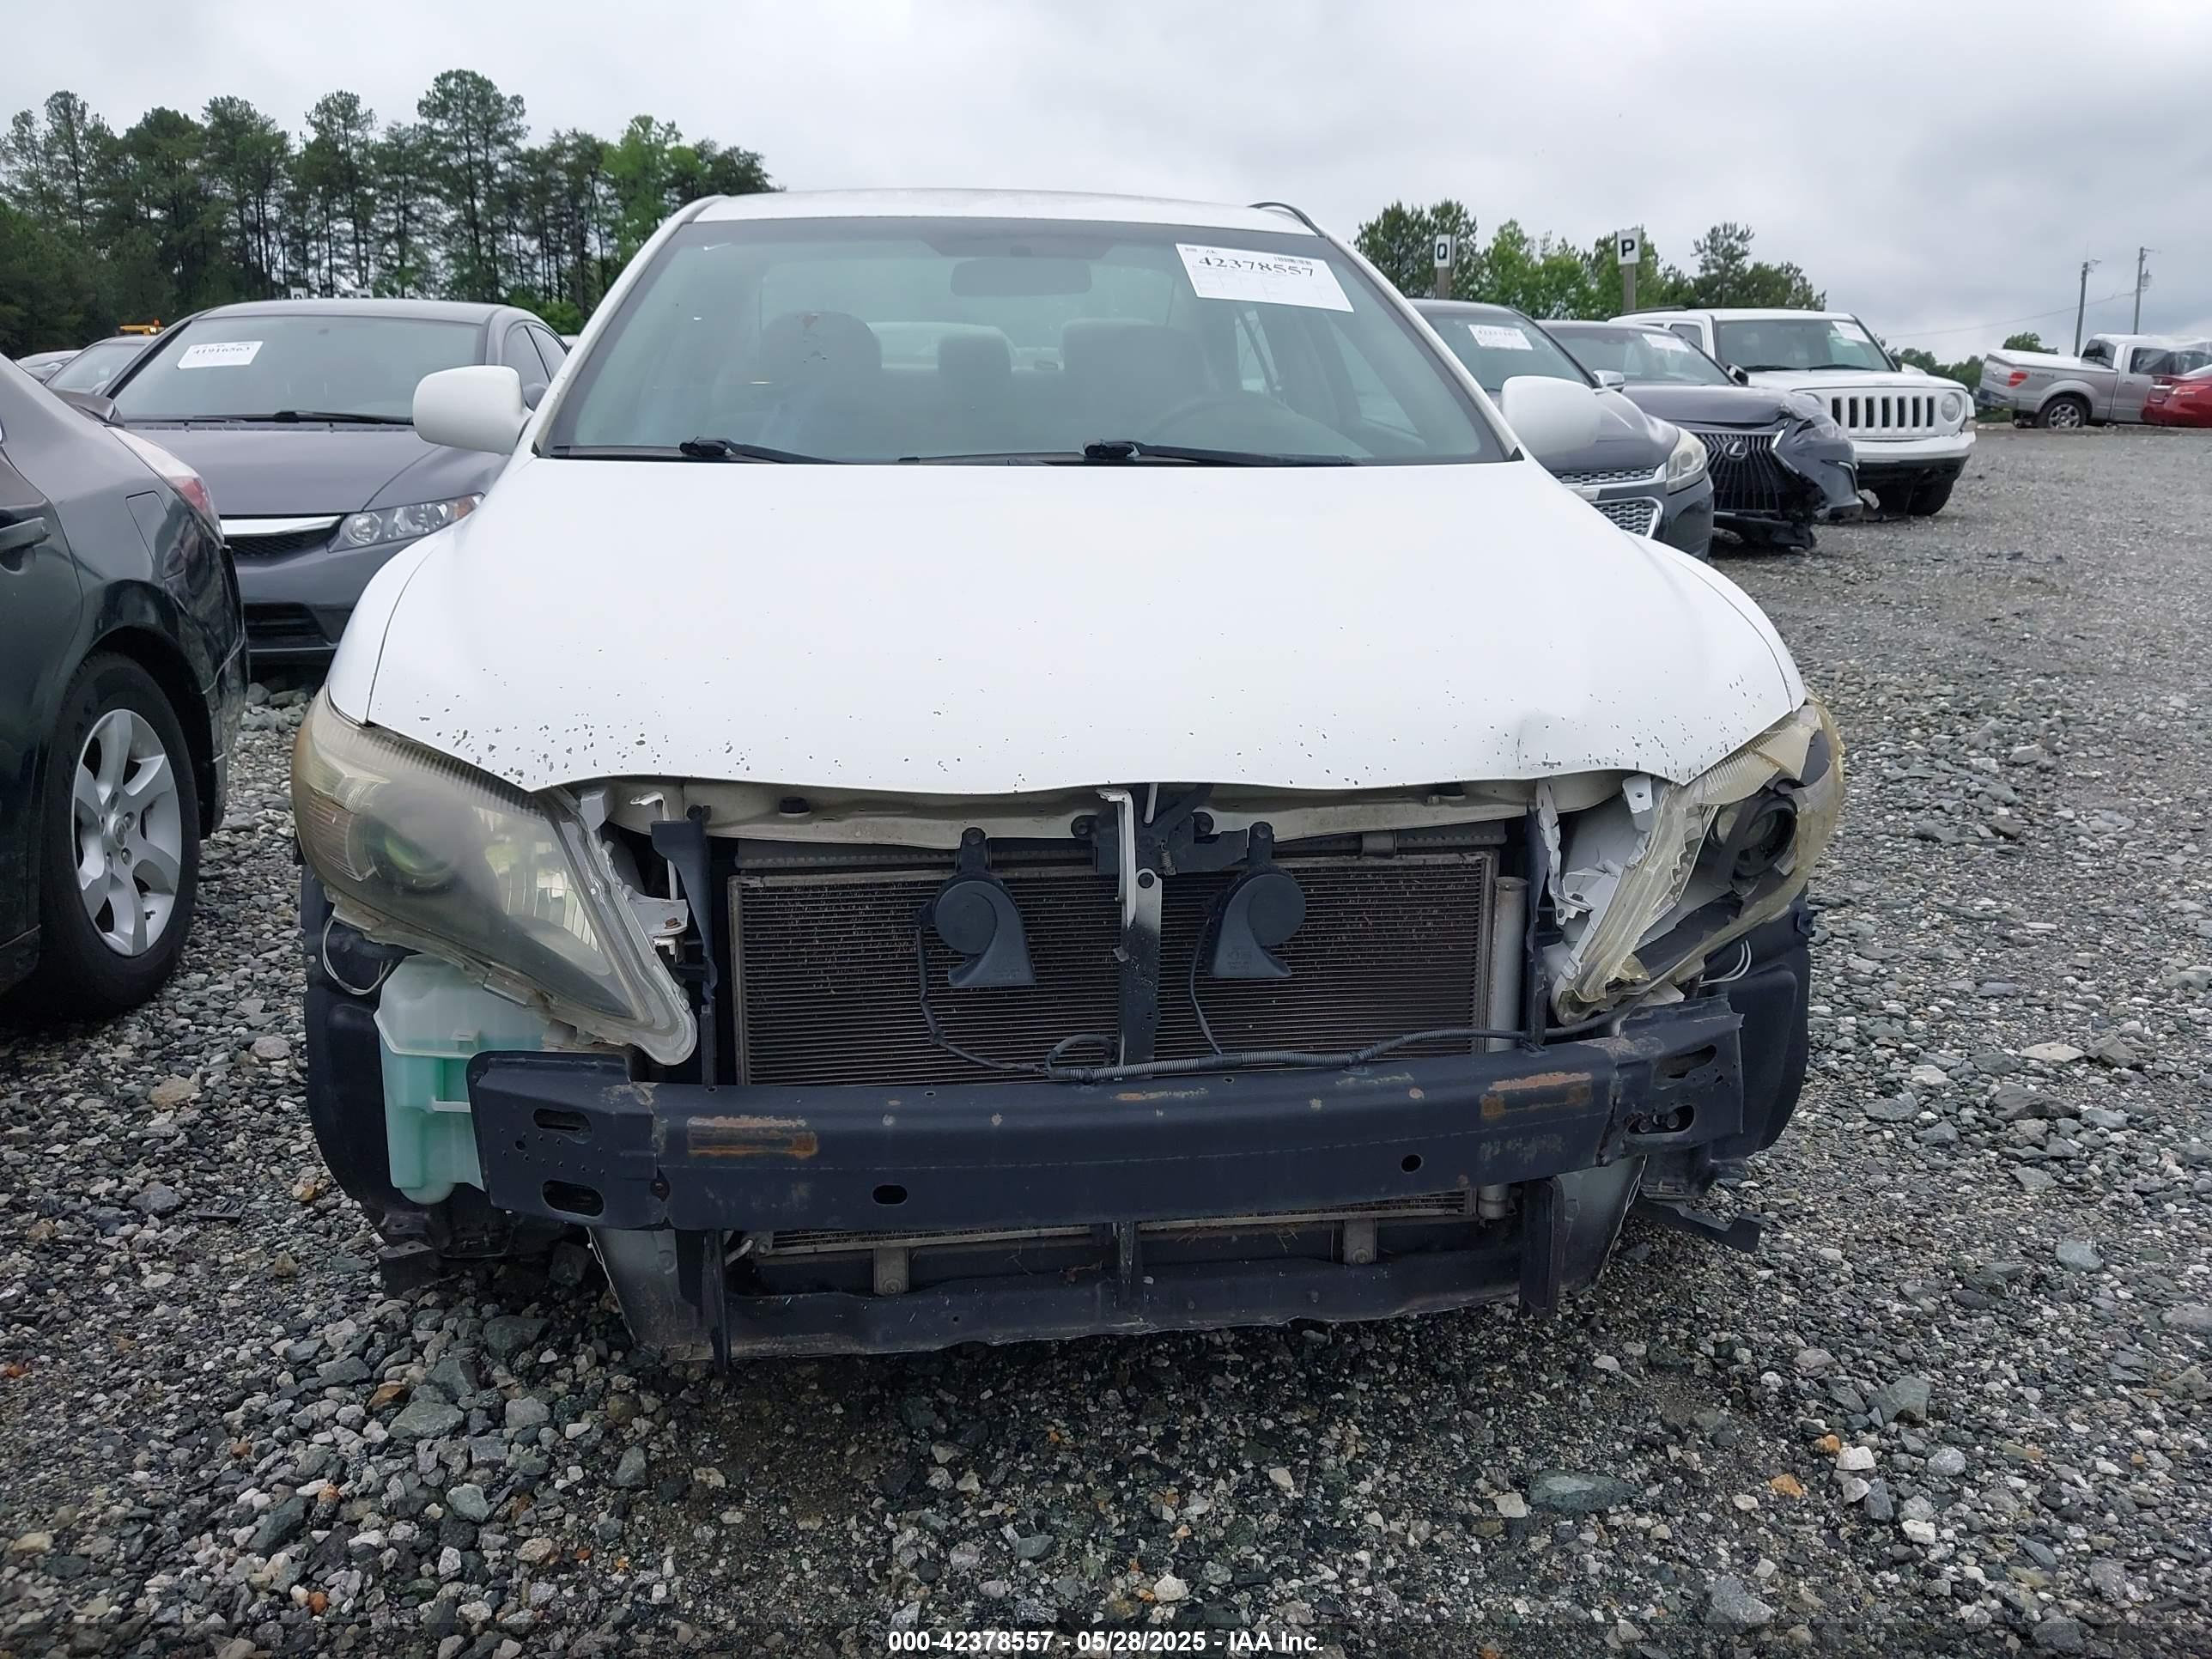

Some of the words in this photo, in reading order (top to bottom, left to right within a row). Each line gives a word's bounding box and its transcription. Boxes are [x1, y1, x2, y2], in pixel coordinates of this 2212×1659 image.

[1437, 242, 1448, 259] Q
[1620, 239, 1636, 258] P
[1198, 256, 1314, 277] 42378557
